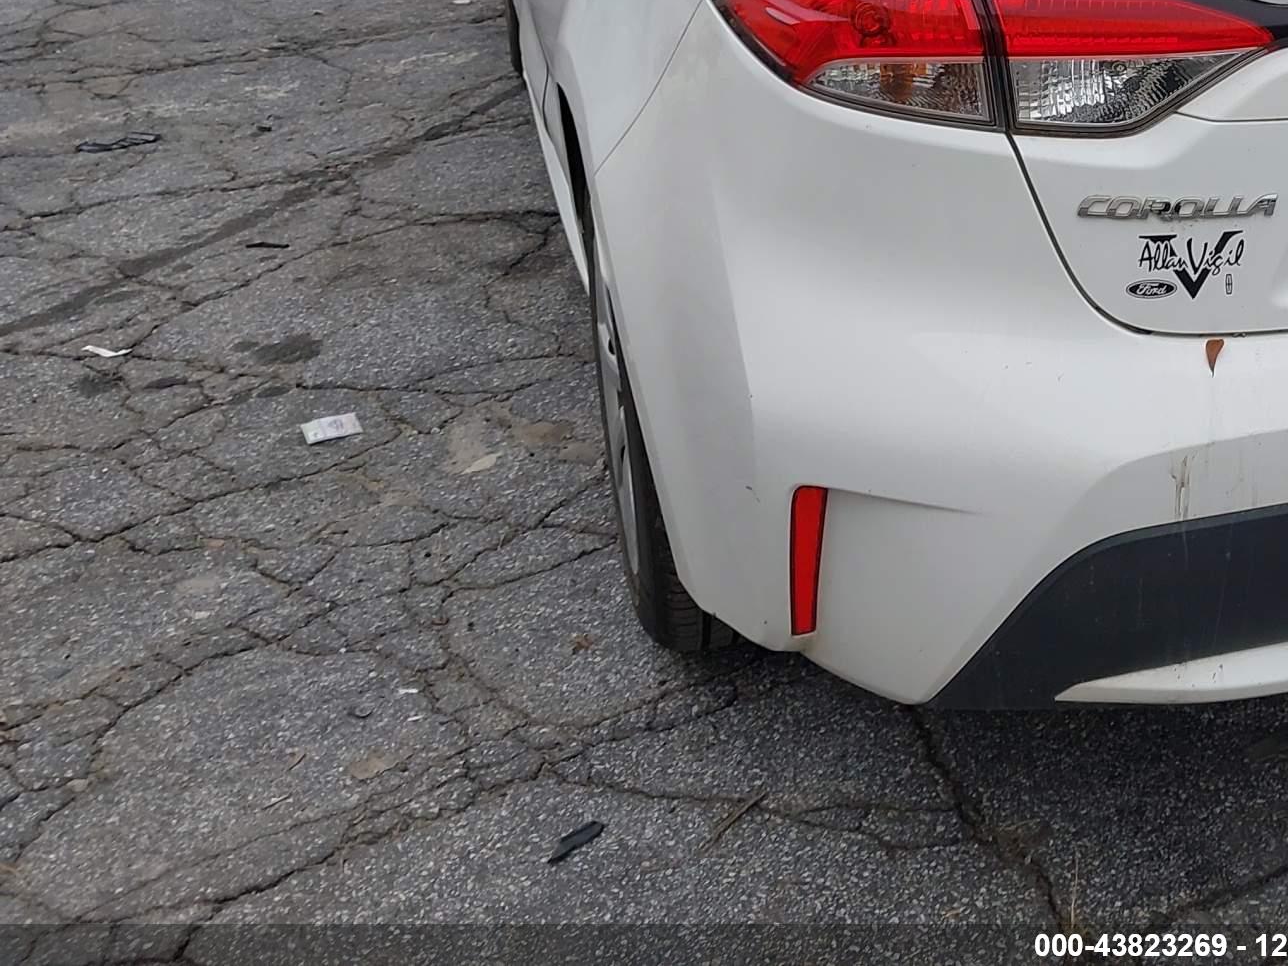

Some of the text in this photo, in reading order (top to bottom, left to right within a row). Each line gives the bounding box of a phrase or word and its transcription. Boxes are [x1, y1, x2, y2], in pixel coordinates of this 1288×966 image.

[1077, 193, 1278, 221] COROLLA
[1139, 237, 1244, 276] Allan Vigil
